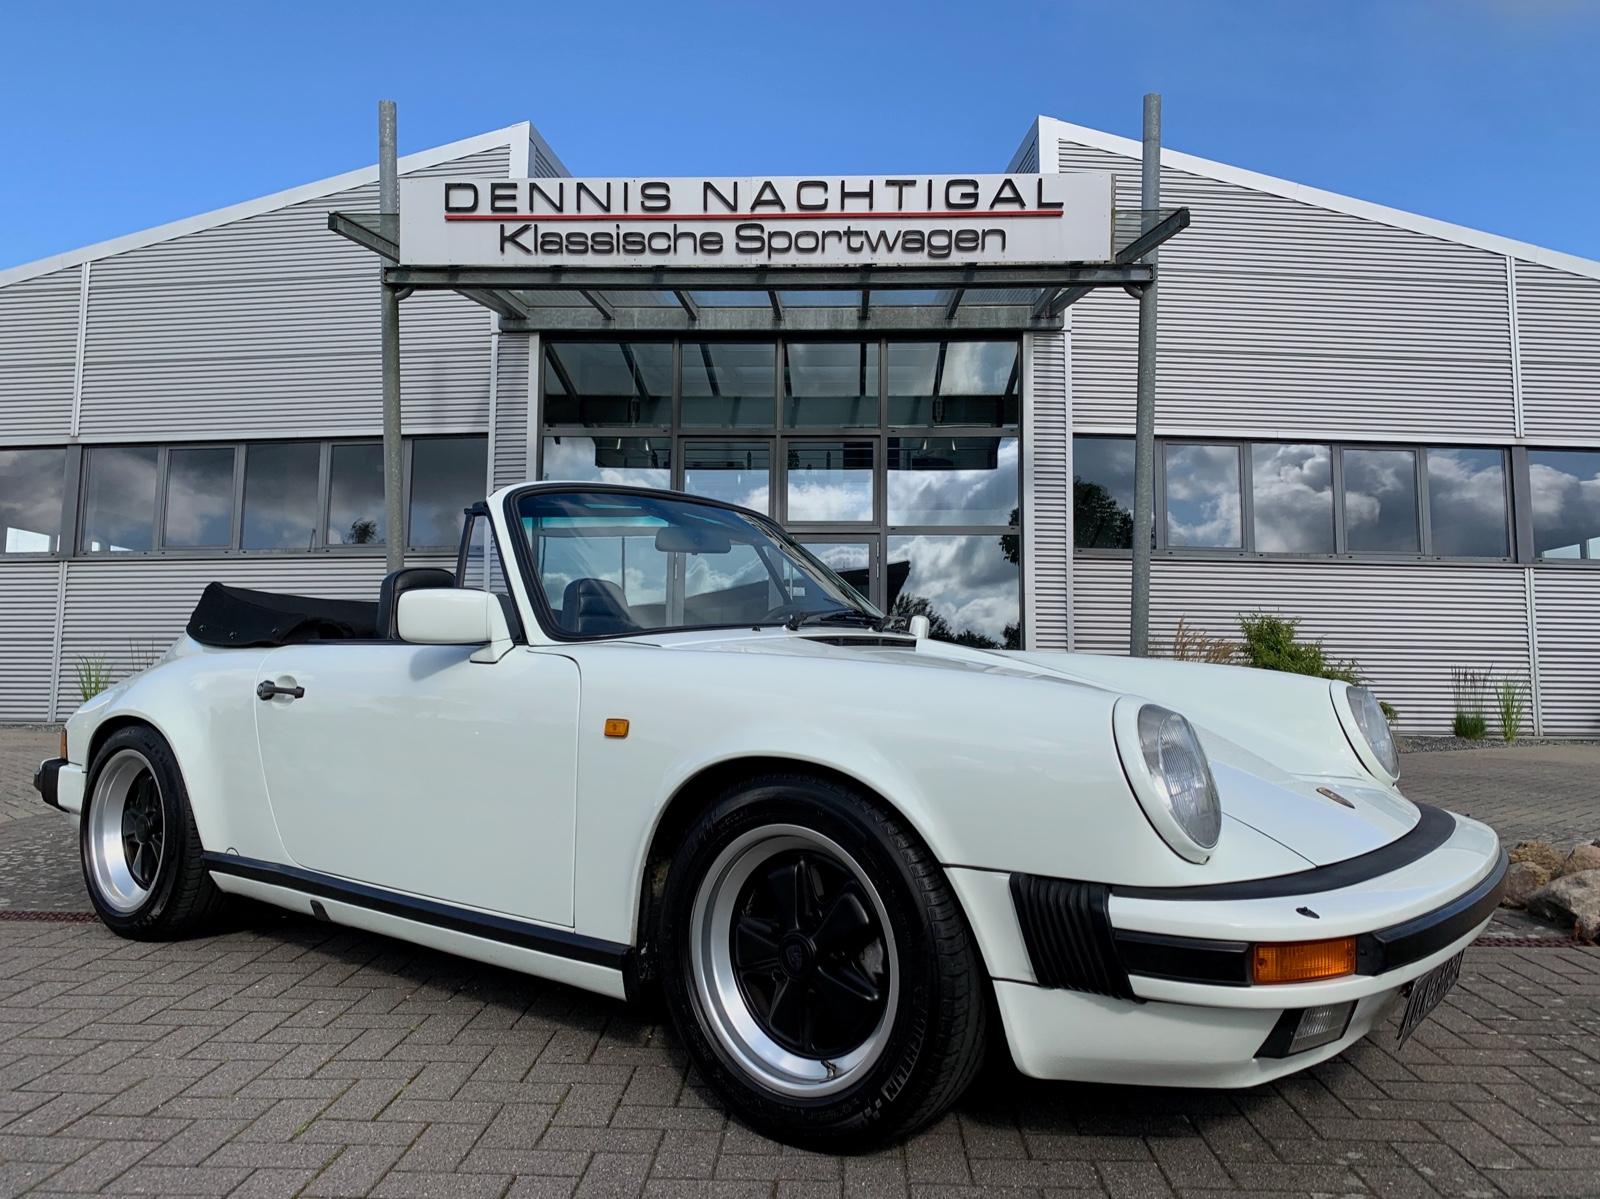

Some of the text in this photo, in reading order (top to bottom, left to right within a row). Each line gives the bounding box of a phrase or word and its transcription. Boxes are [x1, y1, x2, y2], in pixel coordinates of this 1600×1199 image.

[445, 178, 1064, 213] DENNIS NACHTIGAL
[500, 223, 1006, 260] Klassische Sportwagen
